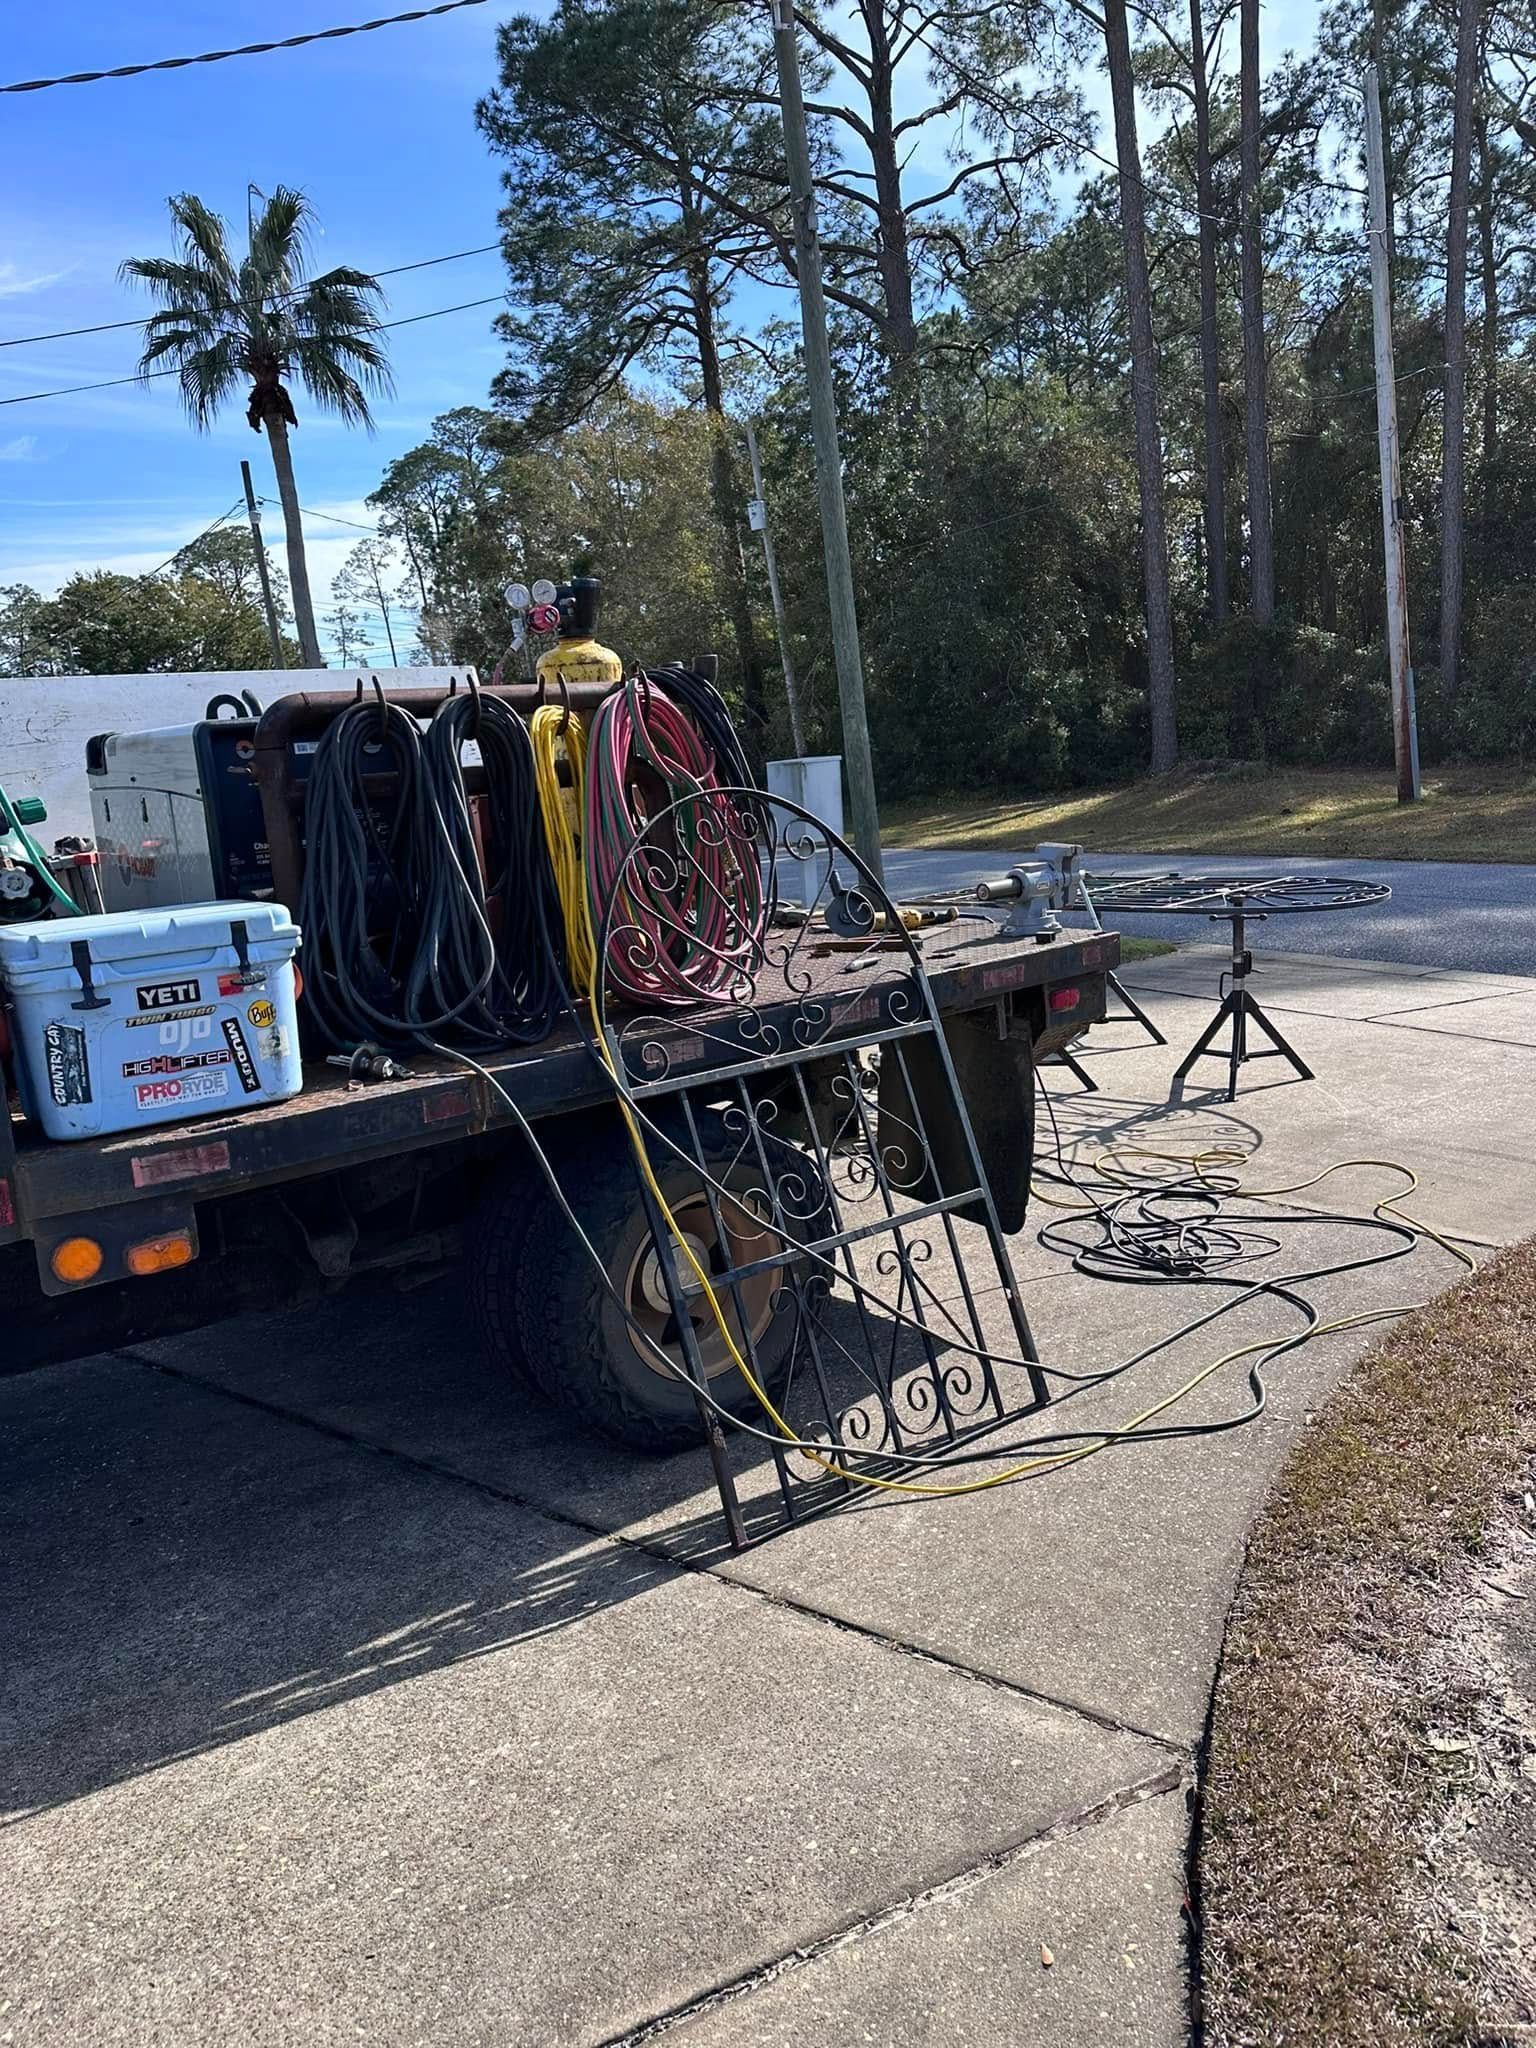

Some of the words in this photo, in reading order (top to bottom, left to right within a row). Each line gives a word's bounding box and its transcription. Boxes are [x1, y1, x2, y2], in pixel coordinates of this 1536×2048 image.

[140, 983, 197, 1006] YETI
[126, 1014, 168, 1027] TWIN
[170, 1005, 217, 1020] TURBO
[123, 1051, 231, 1076] HIGHLIFTER
[49, 1048, 67, 1105] COUNTRY
[137, 1076, 225, 1102] PRORYDE
